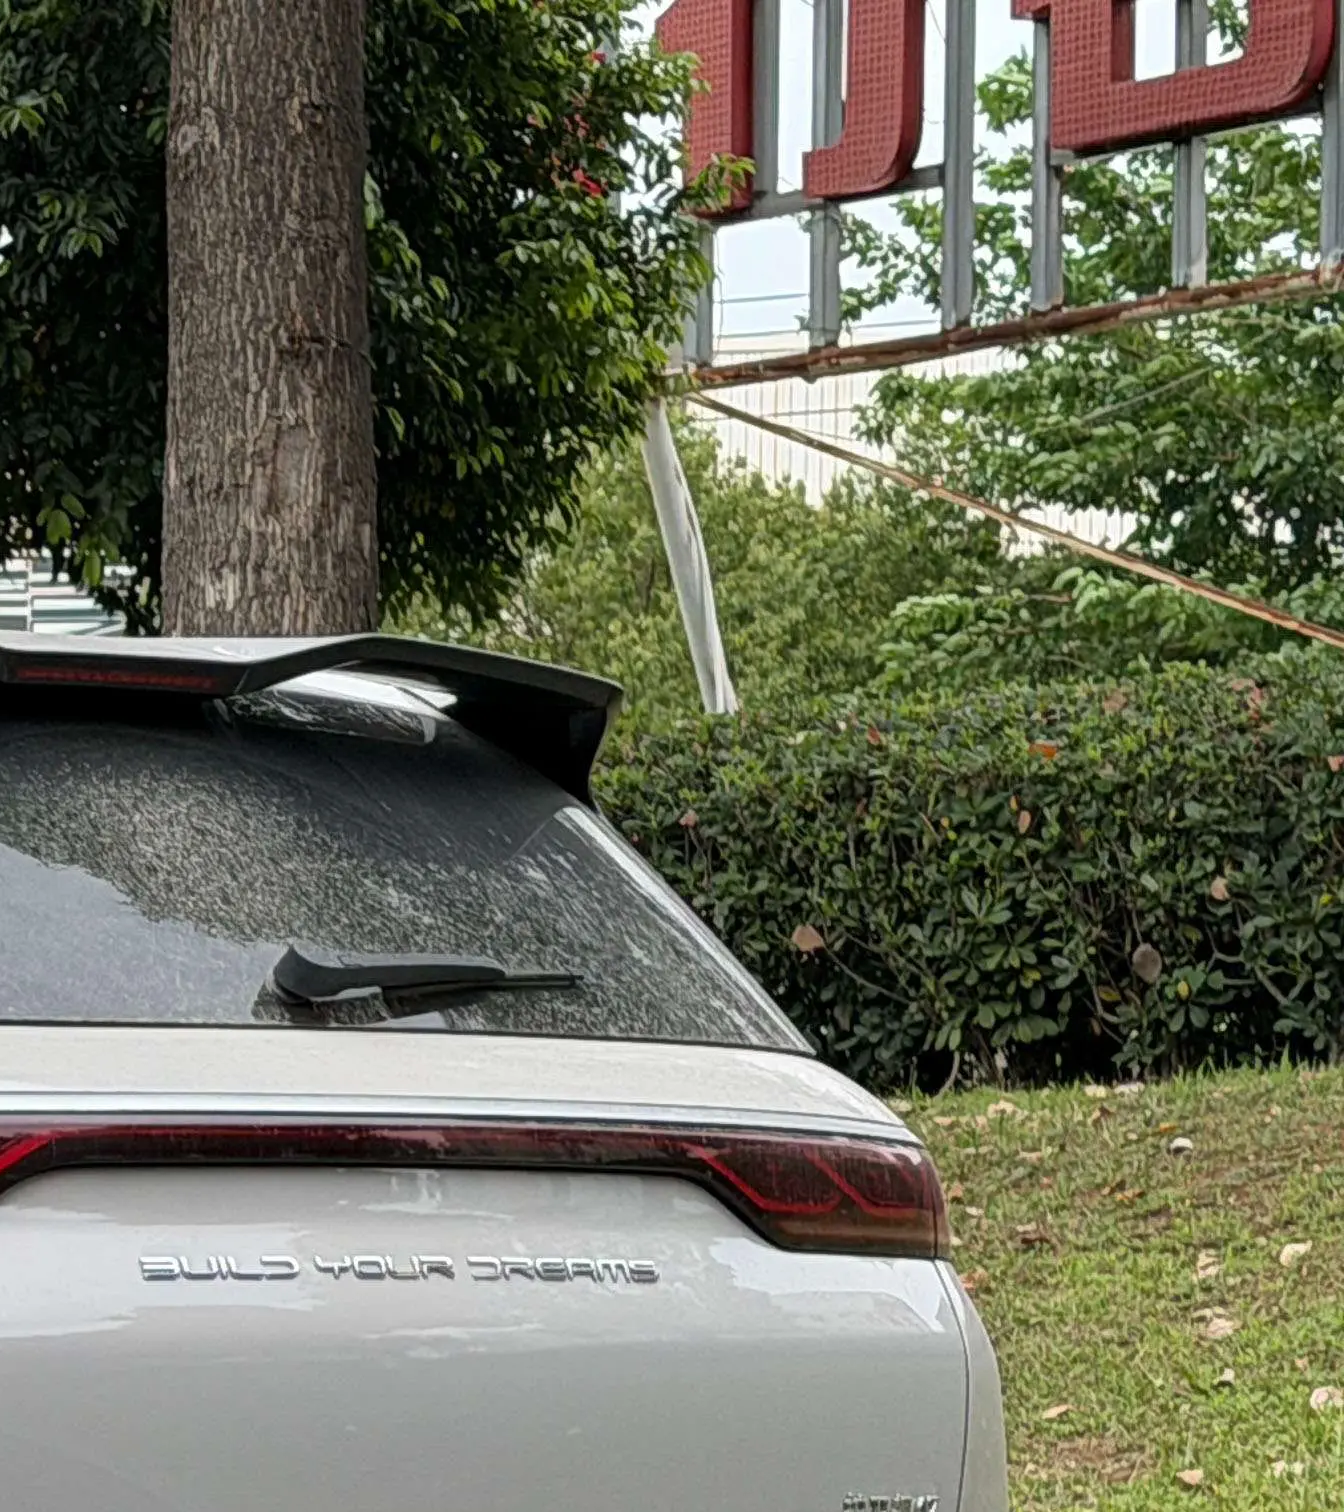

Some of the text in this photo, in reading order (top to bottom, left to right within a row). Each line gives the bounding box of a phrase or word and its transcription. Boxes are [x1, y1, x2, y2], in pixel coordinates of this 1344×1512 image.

[138, 1254, 660, 1284] BUILD YOUR DREAMS
